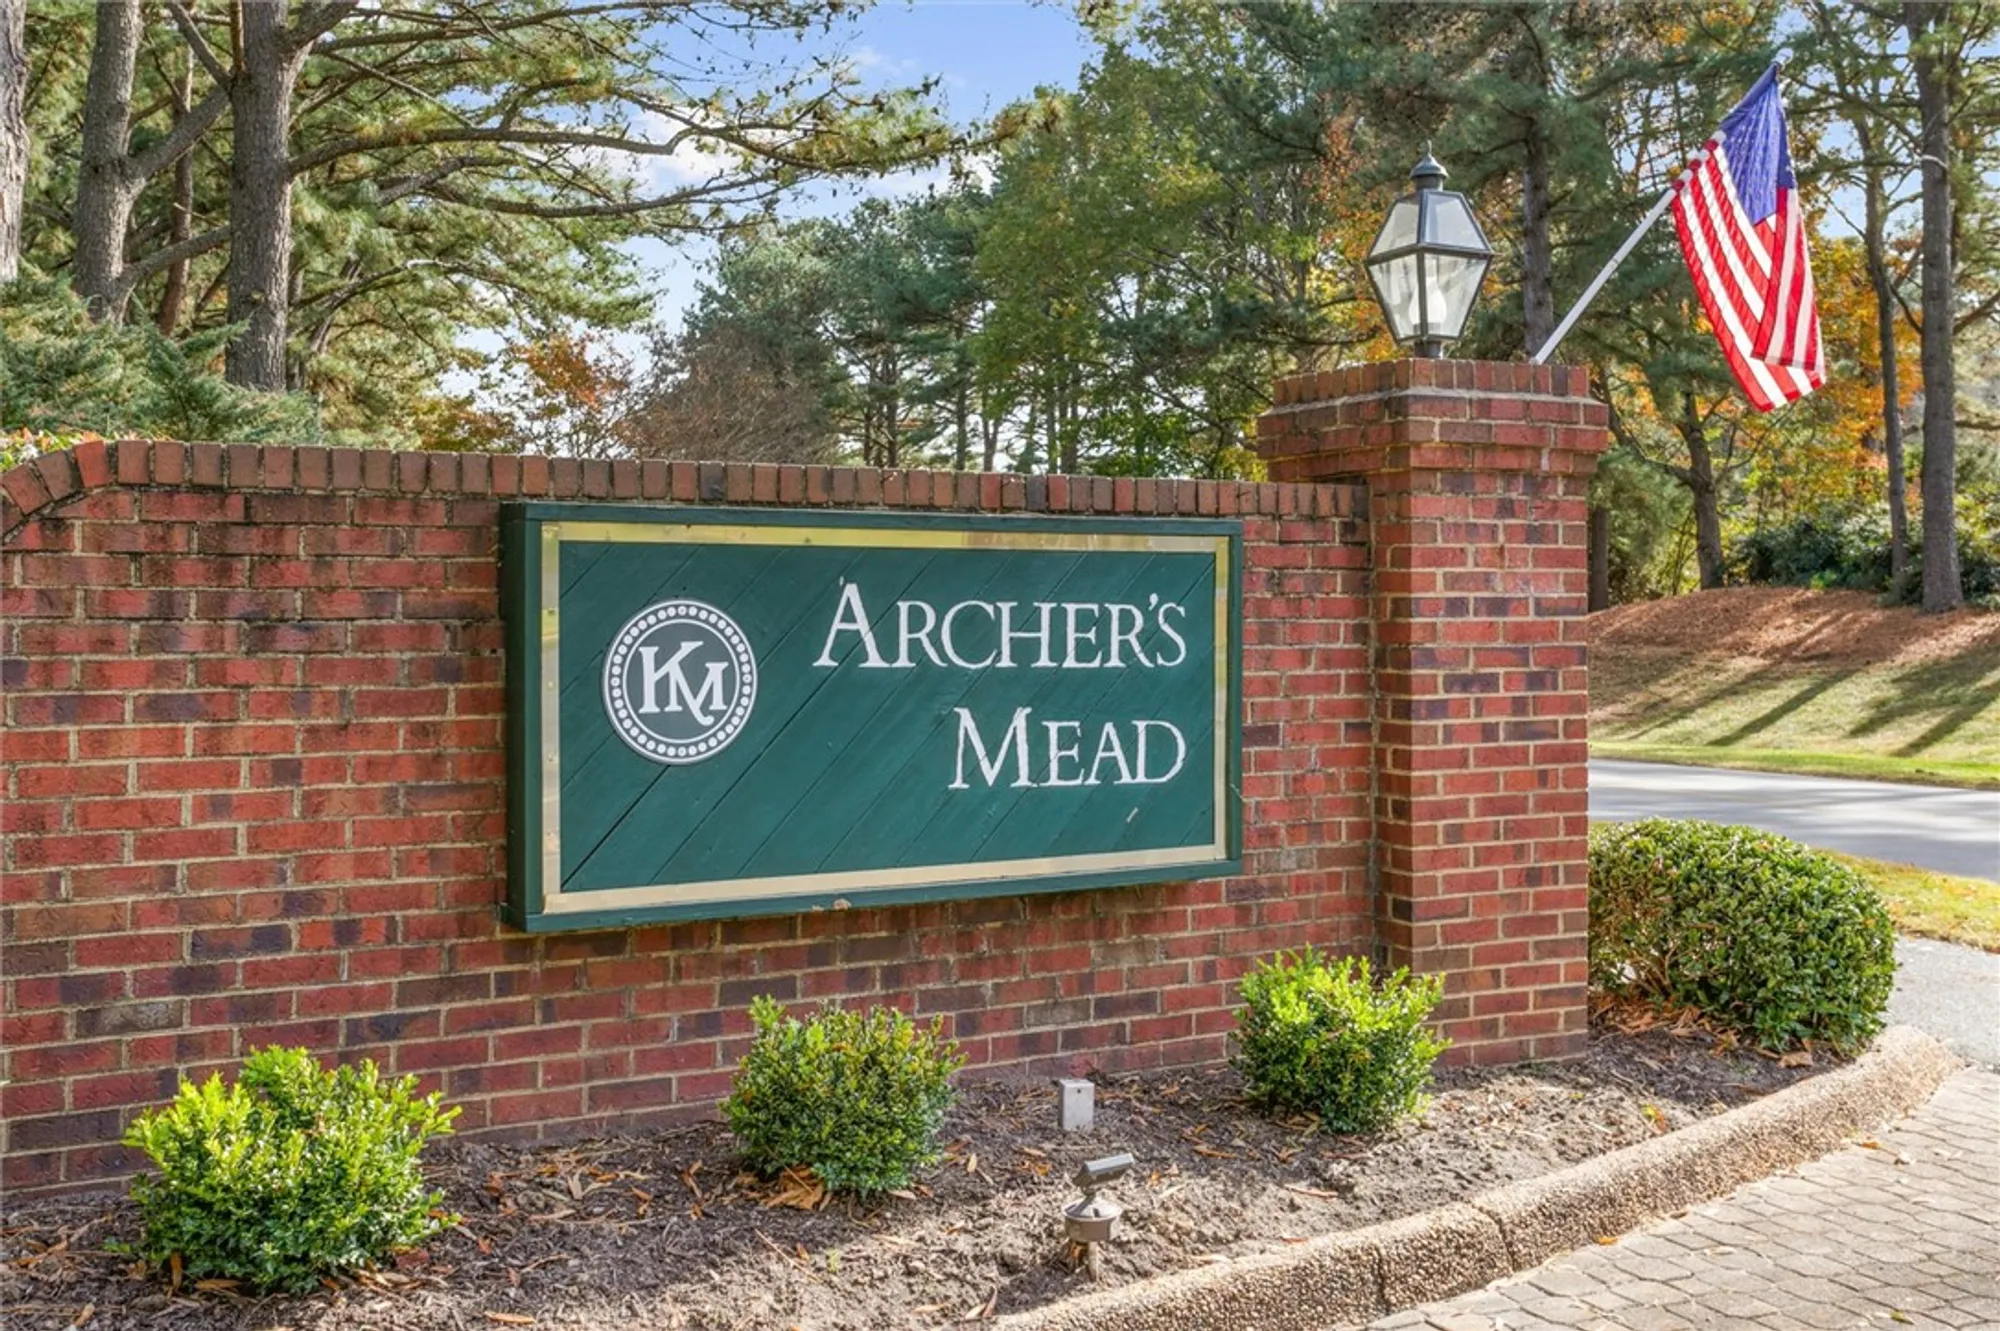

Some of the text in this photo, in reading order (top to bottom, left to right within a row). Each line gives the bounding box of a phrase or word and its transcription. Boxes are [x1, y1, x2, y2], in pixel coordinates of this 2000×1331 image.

[813, 583, 1186, 669] ARCHER'S
[637, 640, 729, 727] KM
[948, 706, 1186, 790] MEAD
